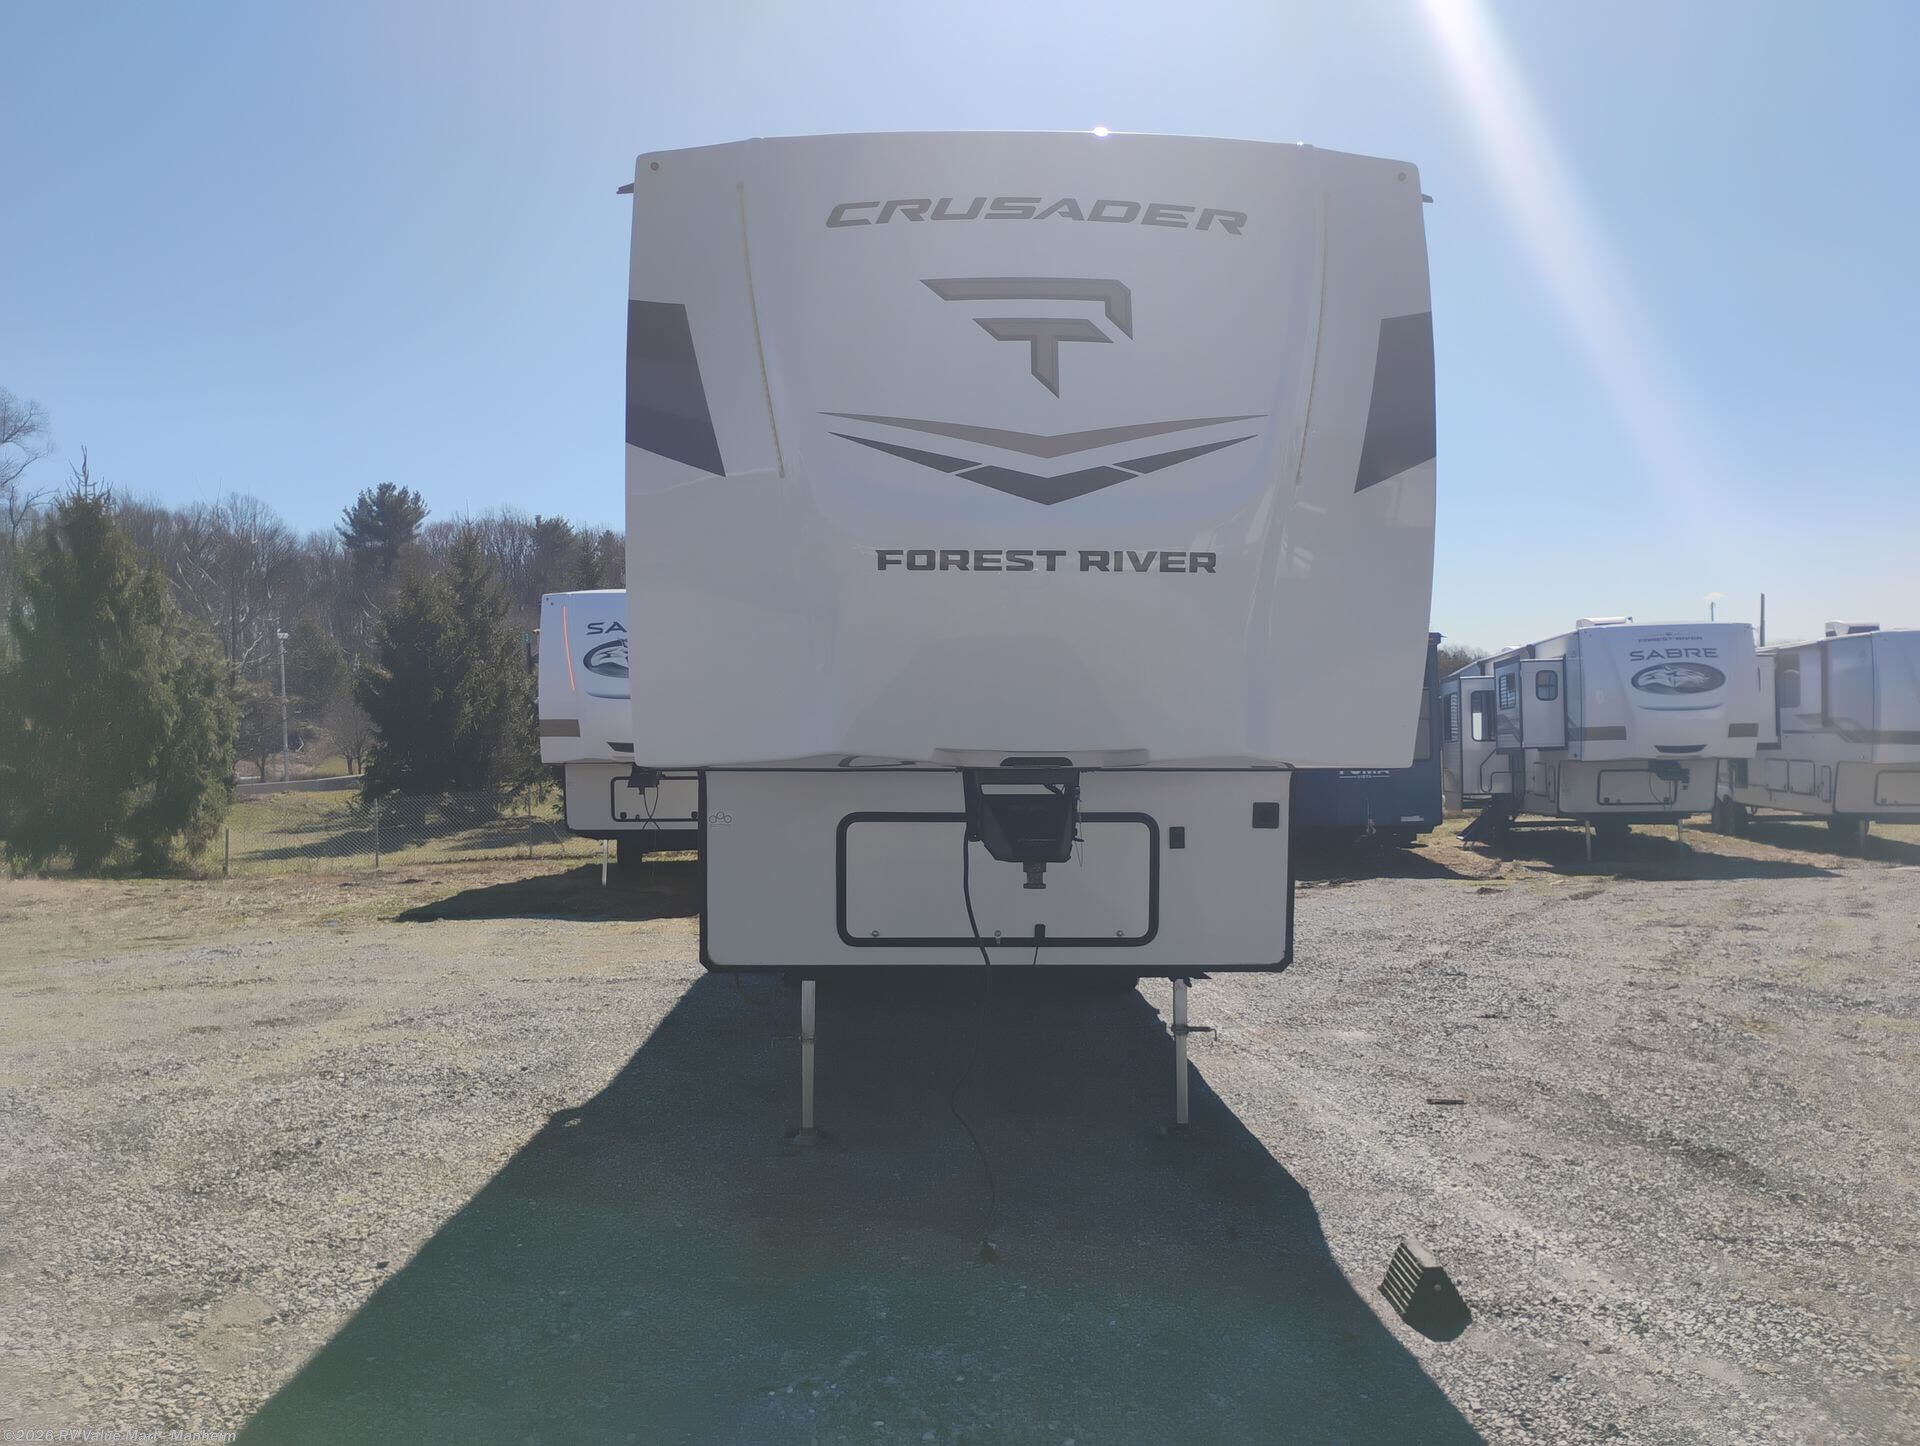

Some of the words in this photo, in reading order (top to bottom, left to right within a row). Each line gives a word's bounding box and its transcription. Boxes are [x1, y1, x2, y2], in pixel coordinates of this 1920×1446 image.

[825, 196, 1248, 236] CRUSADER
[875, 549, 1067, 572] FOREST
[1077, 550, 1217, 574] RIVER
[1629, 647, 1719, 662] SABRE
